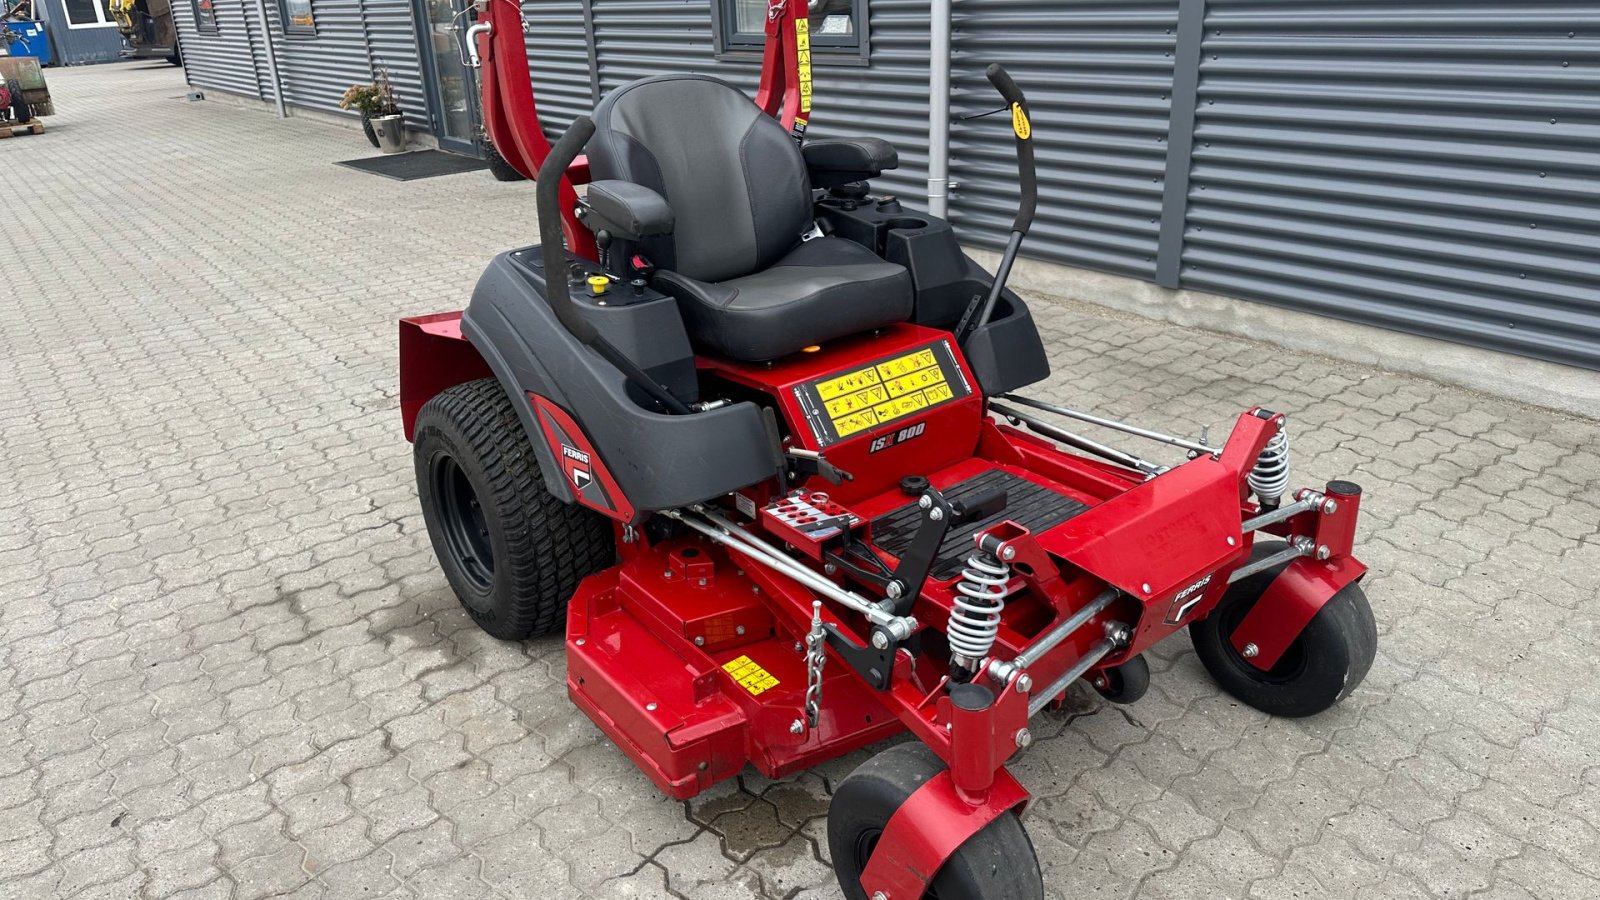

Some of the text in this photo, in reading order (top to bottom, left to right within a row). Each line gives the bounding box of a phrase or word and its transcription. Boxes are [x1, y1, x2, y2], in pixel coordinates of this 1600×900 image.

[869, 422, 926, 453] ISX 800
[563, 446, 589, 464] FERRIS
[1173, 574, 1212, 603] FERRIS
